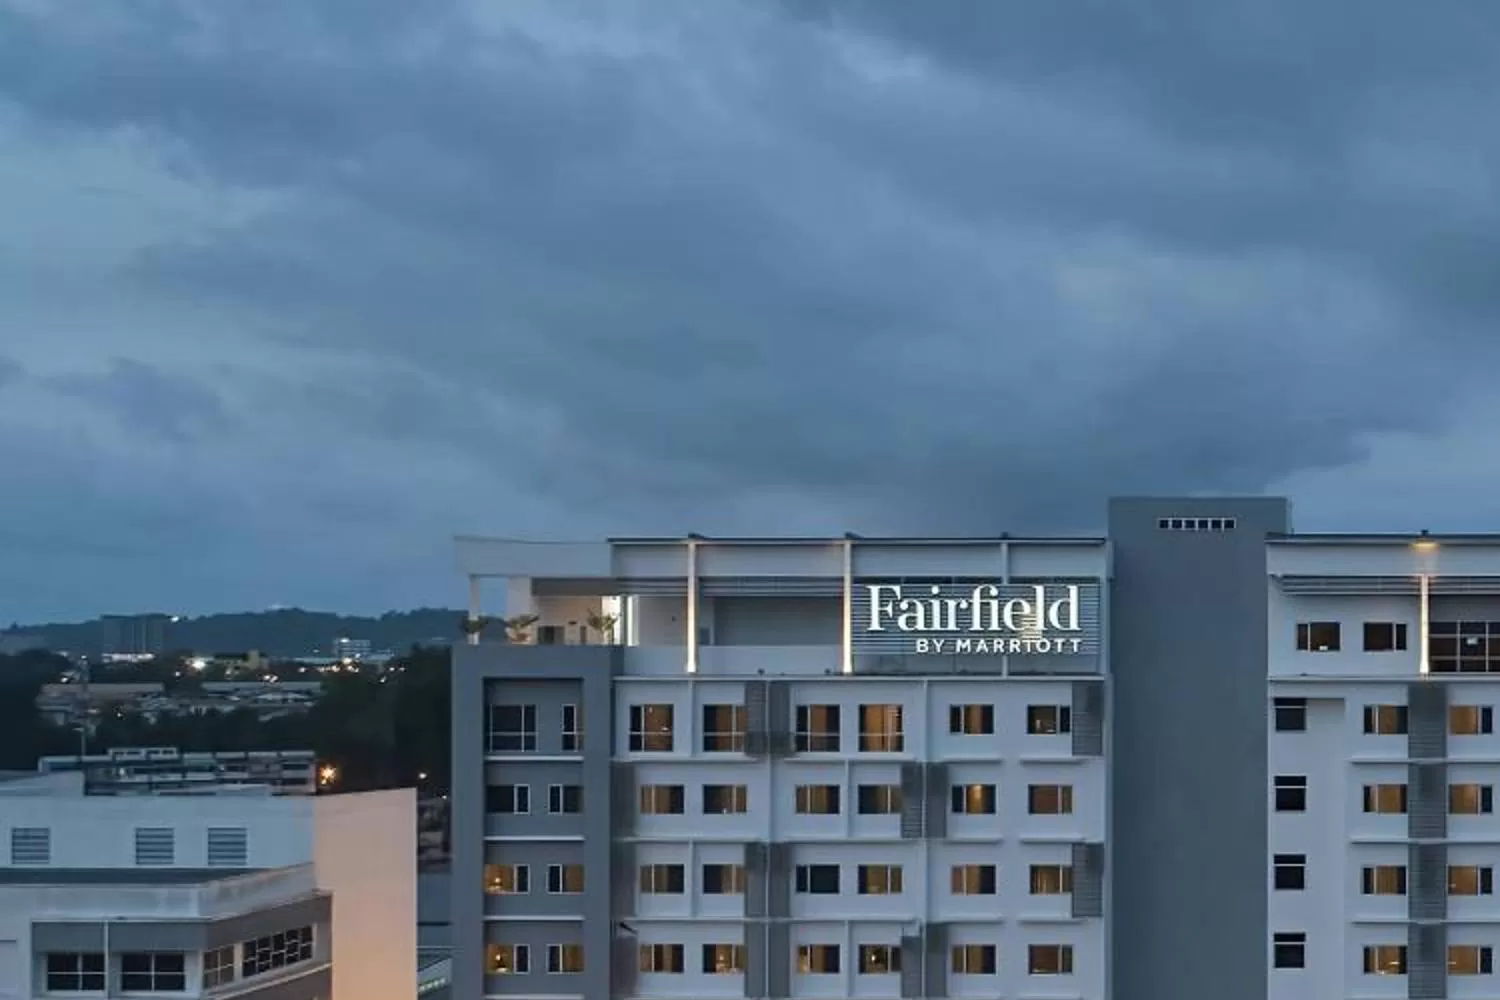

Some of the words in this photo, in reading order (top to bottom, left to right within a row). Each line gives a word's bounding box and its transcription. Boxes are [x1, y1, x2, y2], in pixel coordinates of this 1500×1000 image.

[865, 584, 1082, 632] Fairfield
[916, 638, 945, 653] BY
[955, 638, 1082, 653] MARRIOTT
